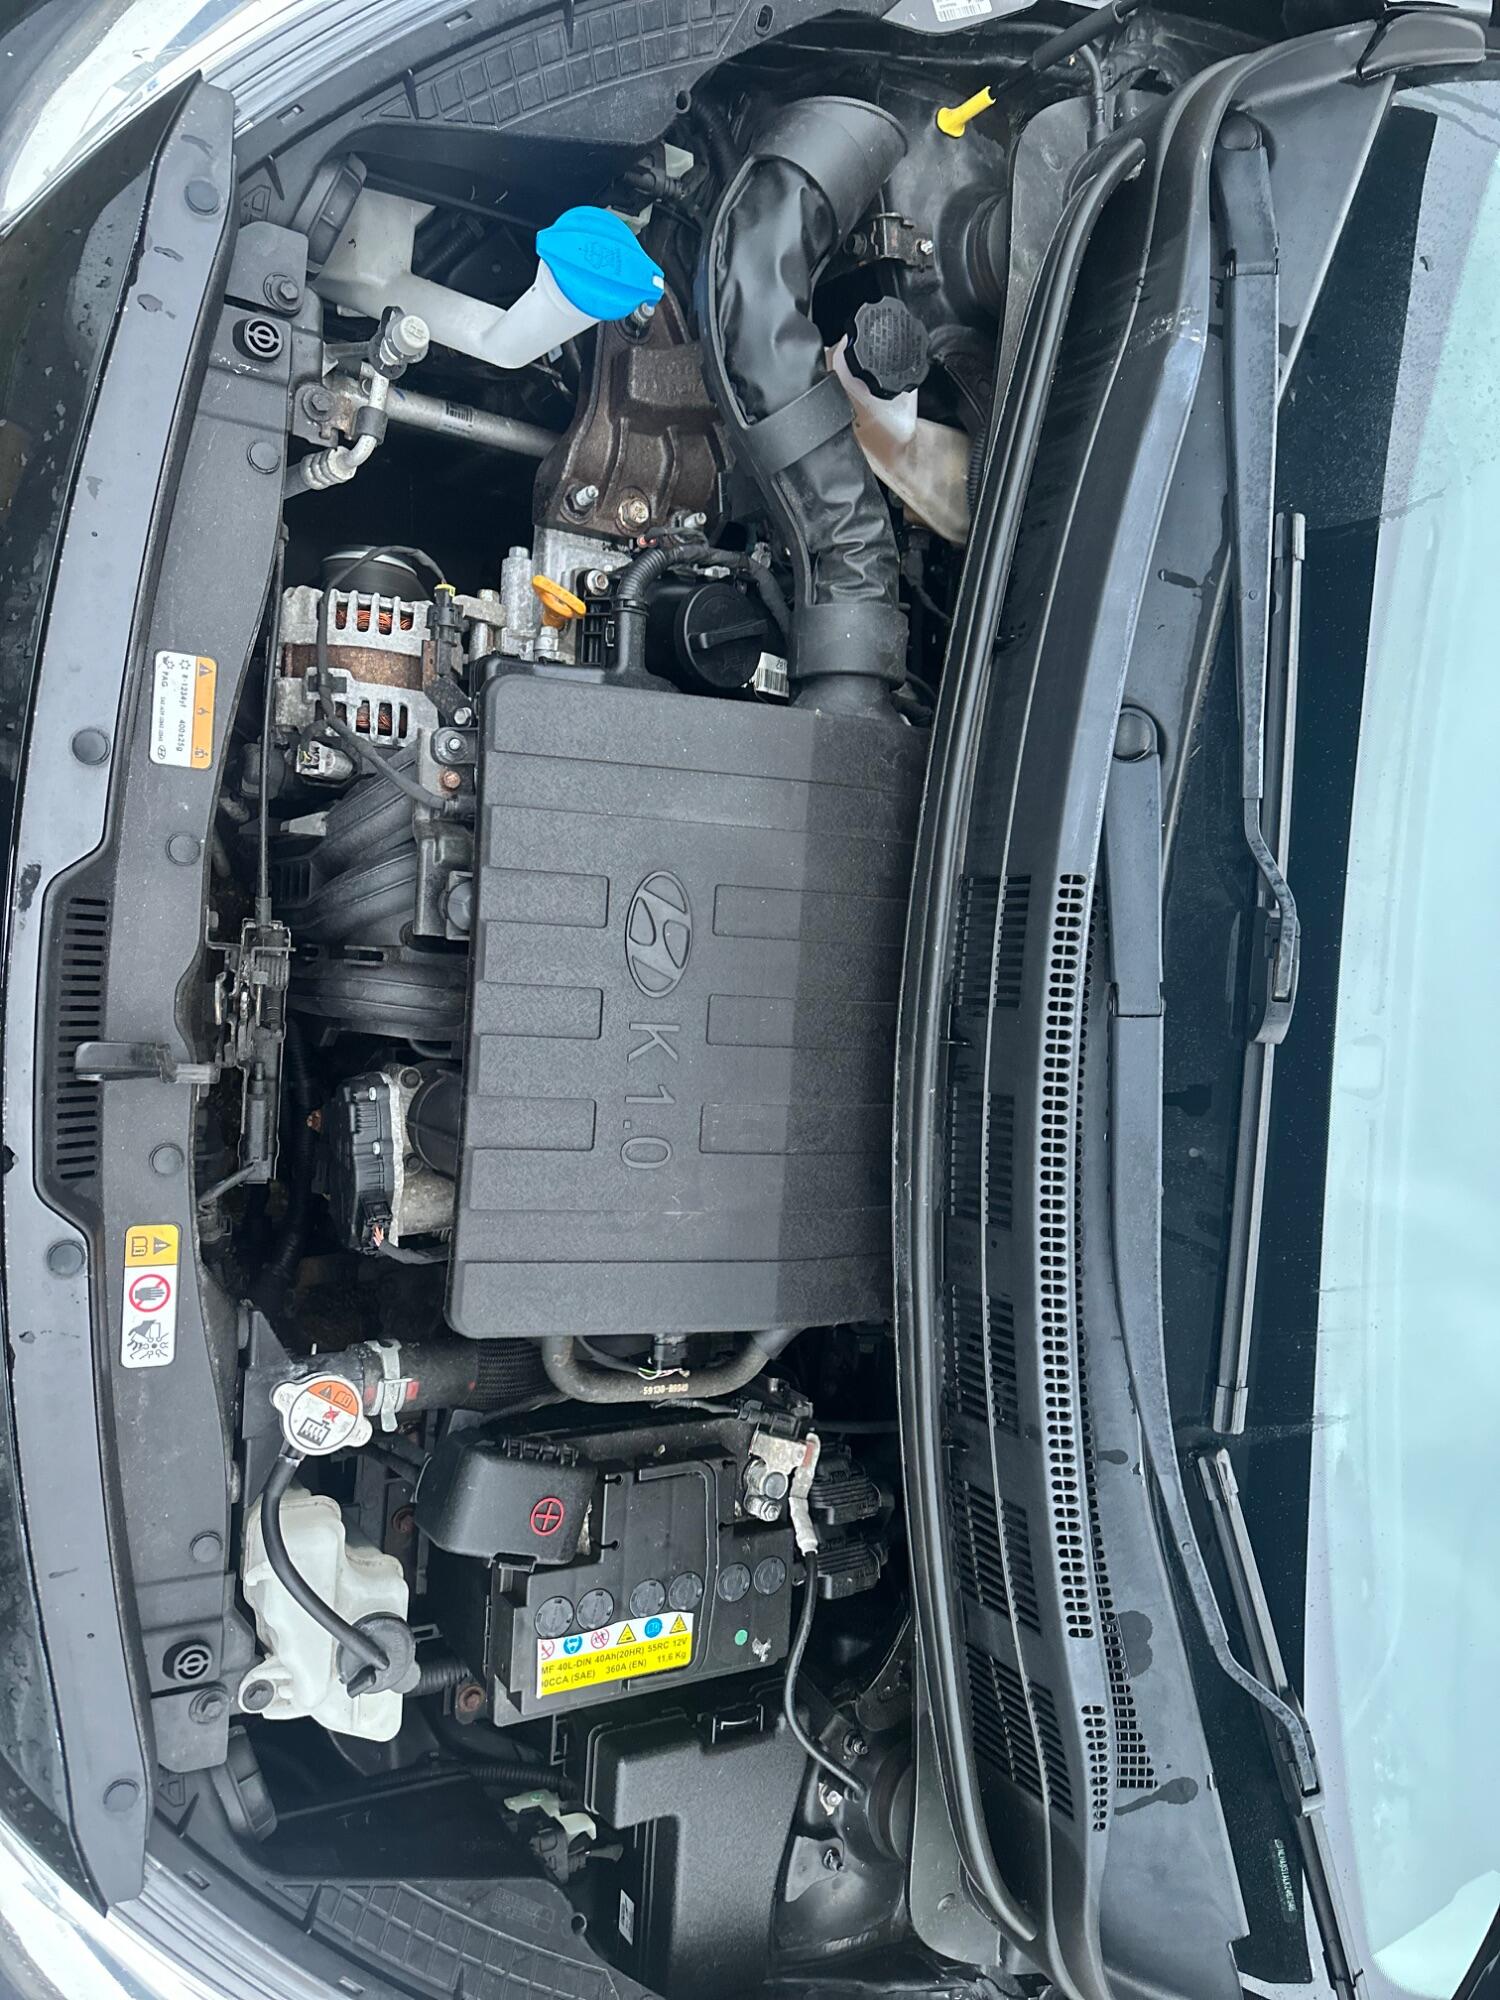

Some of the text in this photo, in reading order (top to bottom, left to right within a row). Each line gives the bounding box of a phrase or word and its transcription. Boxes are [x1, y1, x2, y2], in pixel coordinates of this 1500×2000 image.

[161, 671, 169, 688] PAG
[620, 1021, 681, 1170] K 1.0
[541, 1637, 688, 1675] MF 40L-DIN 40Ah(20HR) 55RC 12V
[570, 1670, 596, 1684] (SAE)
[605, 1662, 627, 1675] 360A
[629, 1659, 647, 1671] (EN)
[674, 1651, 687, 1661] Kg
